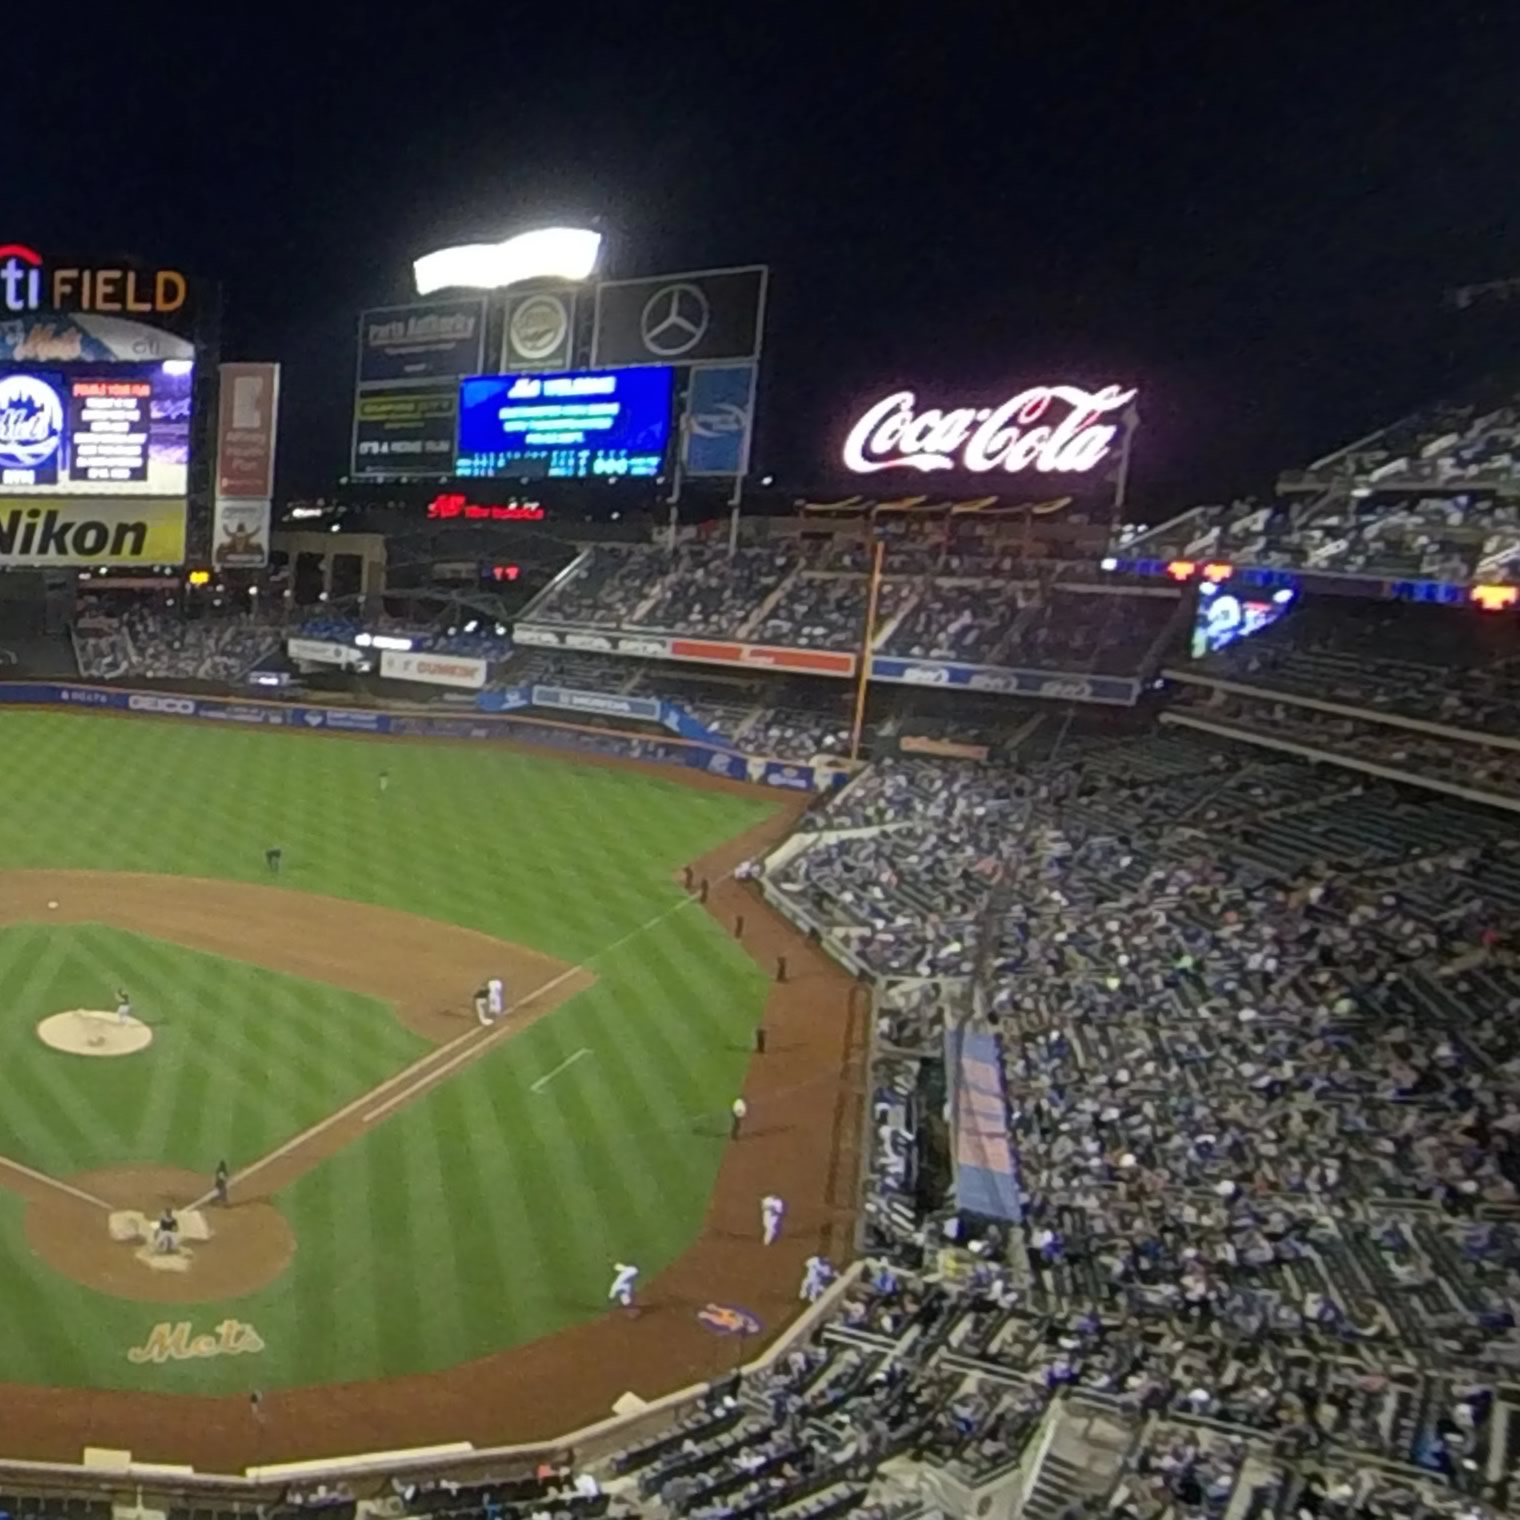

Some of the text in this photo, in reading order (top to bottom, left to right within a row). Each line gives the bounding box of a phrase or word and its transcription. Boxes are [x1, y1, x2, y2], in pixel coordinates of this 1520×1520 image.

[53, 269, 186, 311] FIELD
[843, 385, 1138, 473] Coca-Cola
[128, 1319, 265, 1363] Mets
